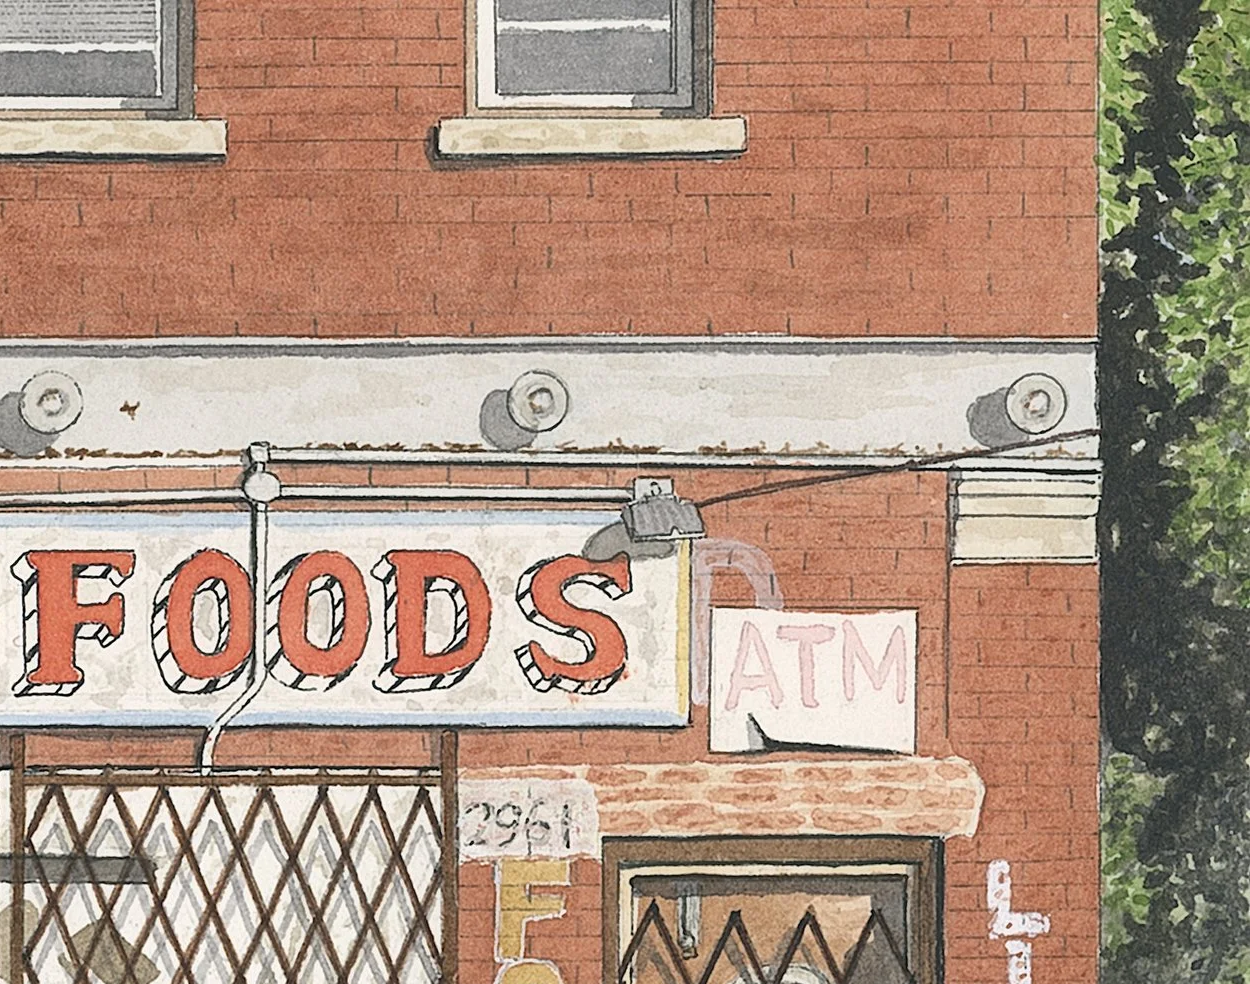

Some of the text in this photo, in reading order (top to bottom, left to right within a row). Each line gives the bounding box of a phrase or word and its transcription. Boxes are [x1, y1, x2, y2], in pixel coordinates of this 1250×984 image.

[10, 549, 632, 695] FOODS
[724, 619, 908, 711] ATM
[463, 798, 572, 850] 2961
